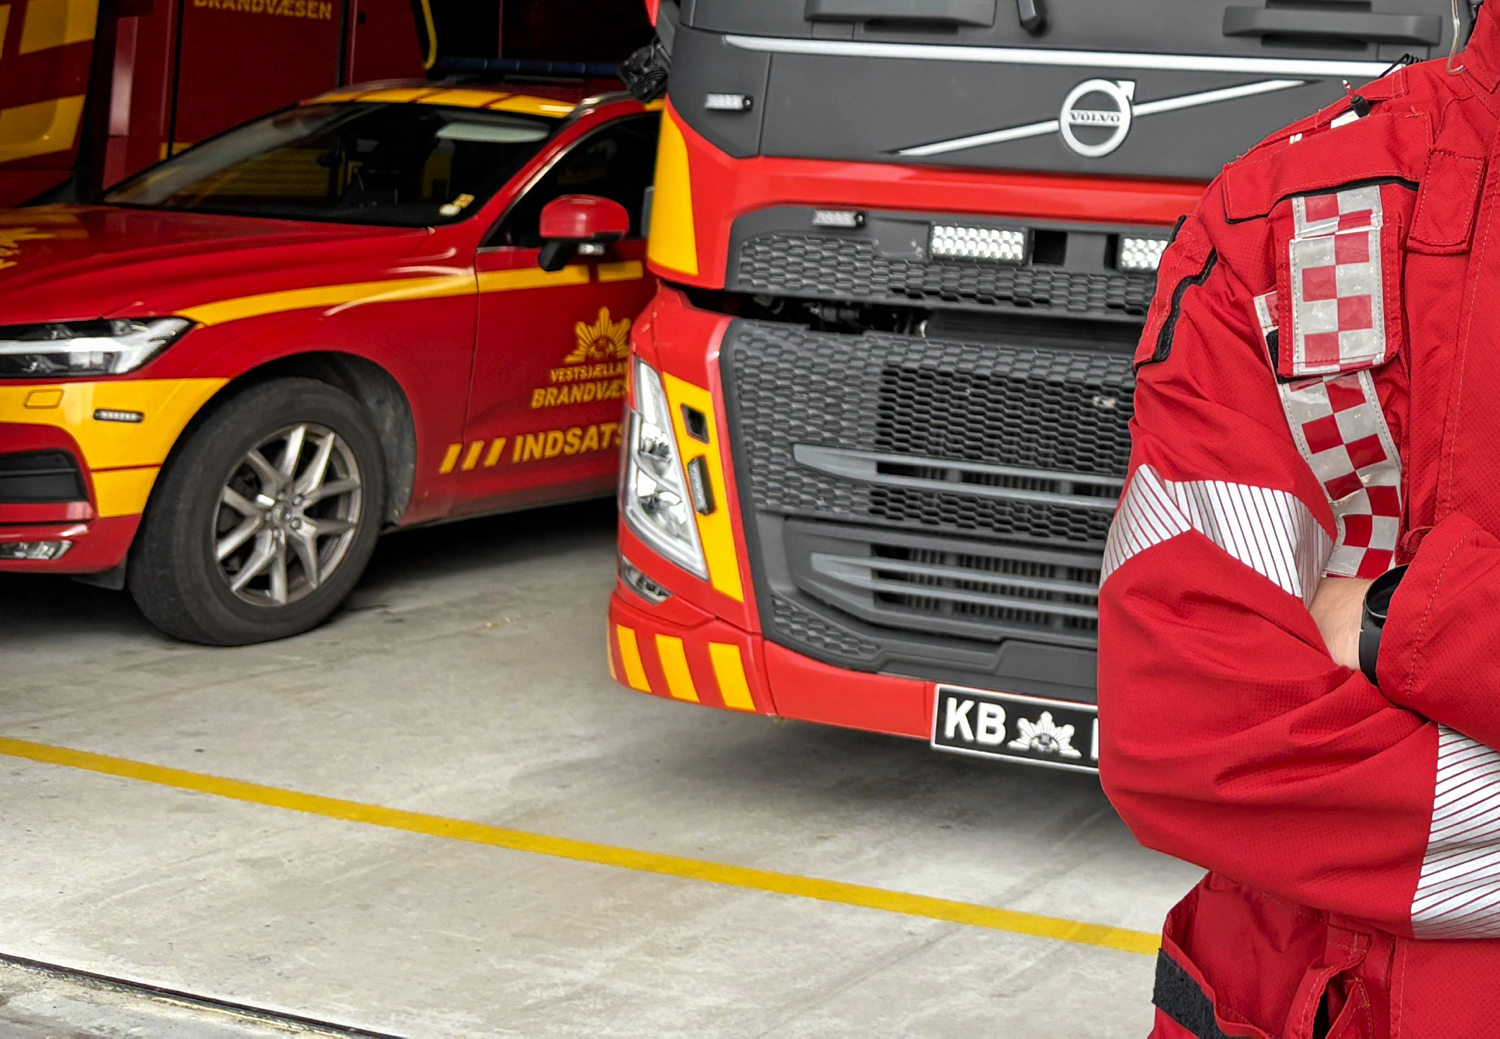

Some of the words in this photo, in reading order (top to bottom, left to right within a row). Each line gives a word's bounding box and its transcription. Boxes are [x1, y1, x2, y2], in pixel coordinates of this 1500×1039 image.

[1070, 111, 1121, 123] VOLVO
[550, 361, 628, 382] VESTSJÆLLA
[531, 378, 627, 410] BRANDVÆ
[944, 696, 1006, 746] KB
